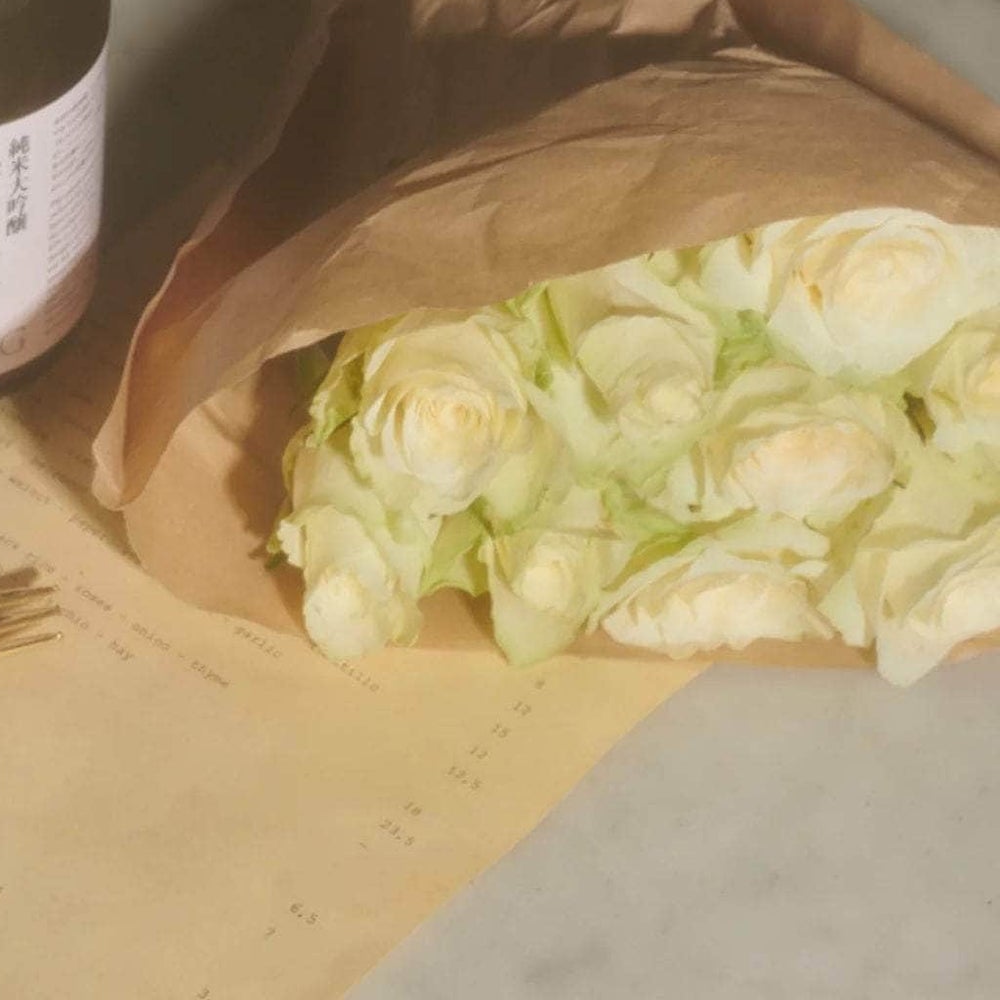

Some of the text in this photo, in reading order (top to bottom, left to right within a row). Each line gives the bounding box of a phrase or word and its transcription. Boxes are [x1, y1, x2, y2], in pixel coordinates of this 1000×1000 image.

[5, 135, 30, 237] 純米大吟醸
